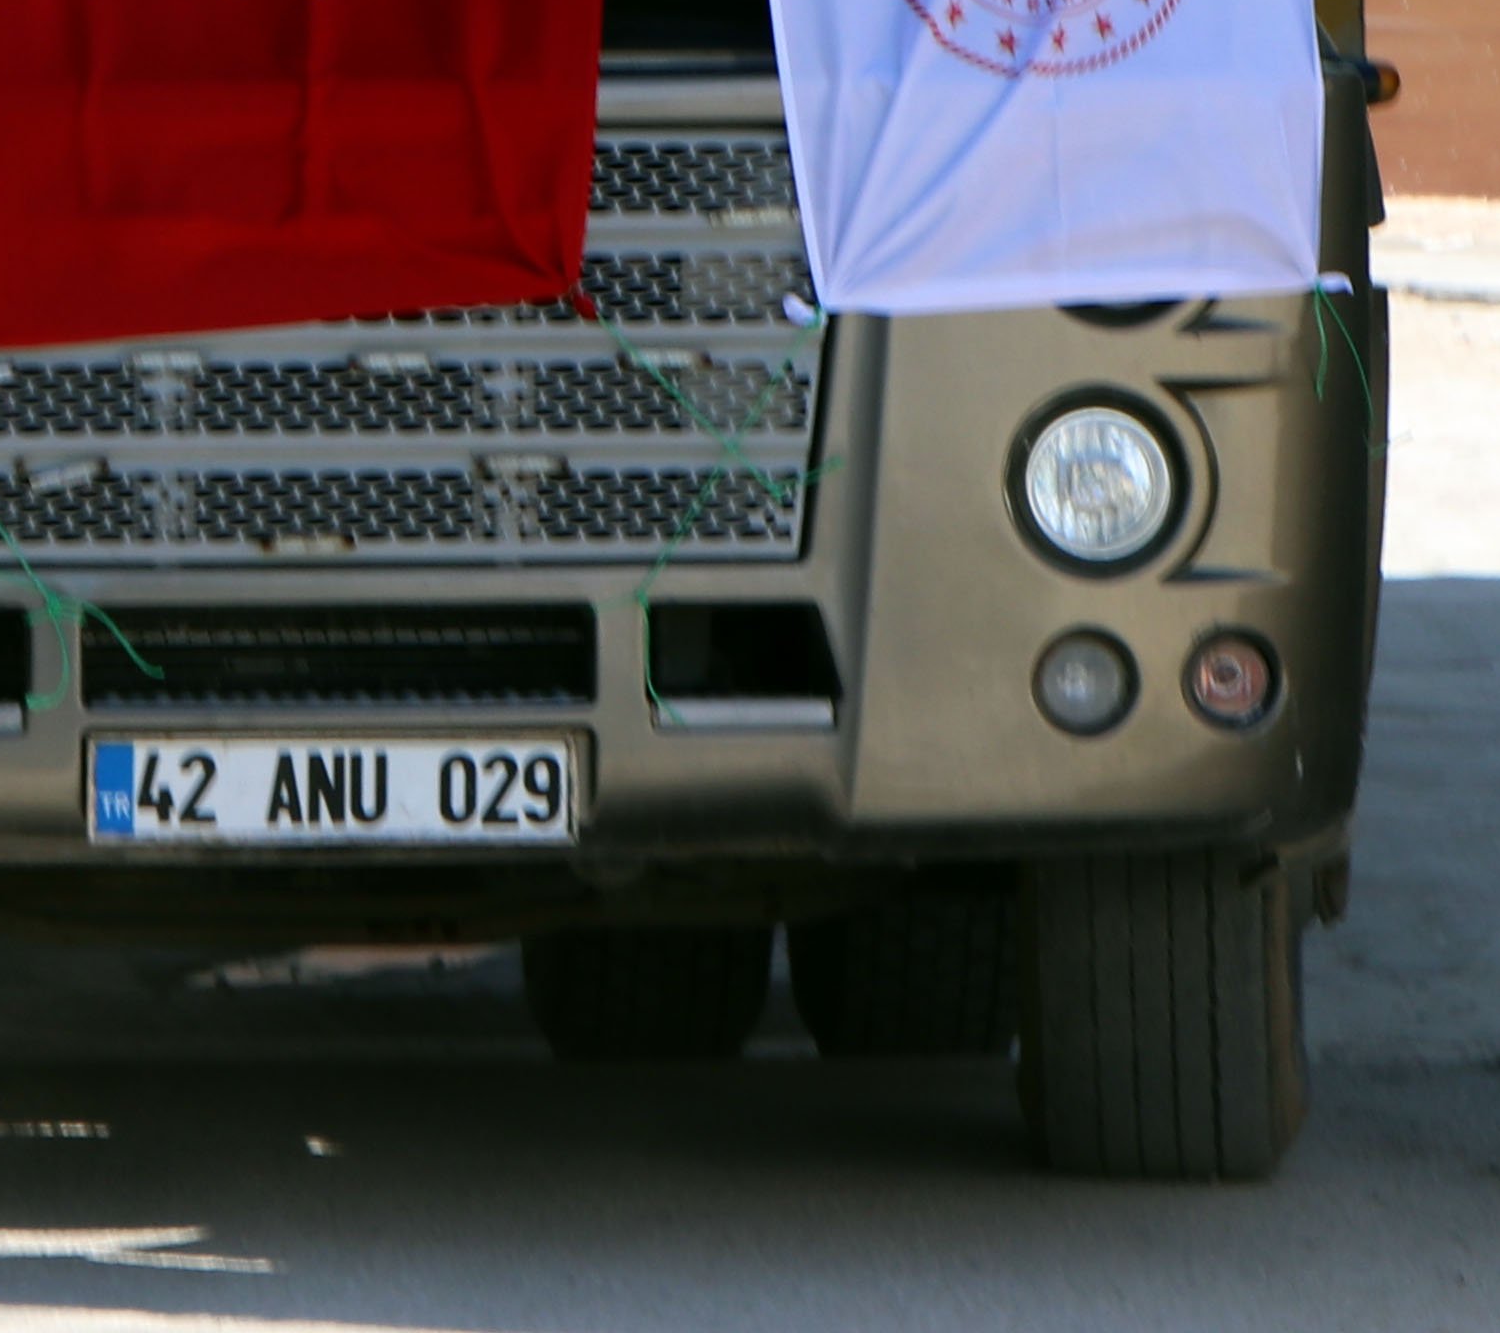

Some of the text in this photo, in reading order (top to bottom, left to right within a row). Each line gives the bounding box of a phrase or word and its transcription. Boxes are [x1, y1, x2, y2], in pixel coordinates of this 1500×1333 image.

[138, 748, 562, 824] 42 ANU 029
